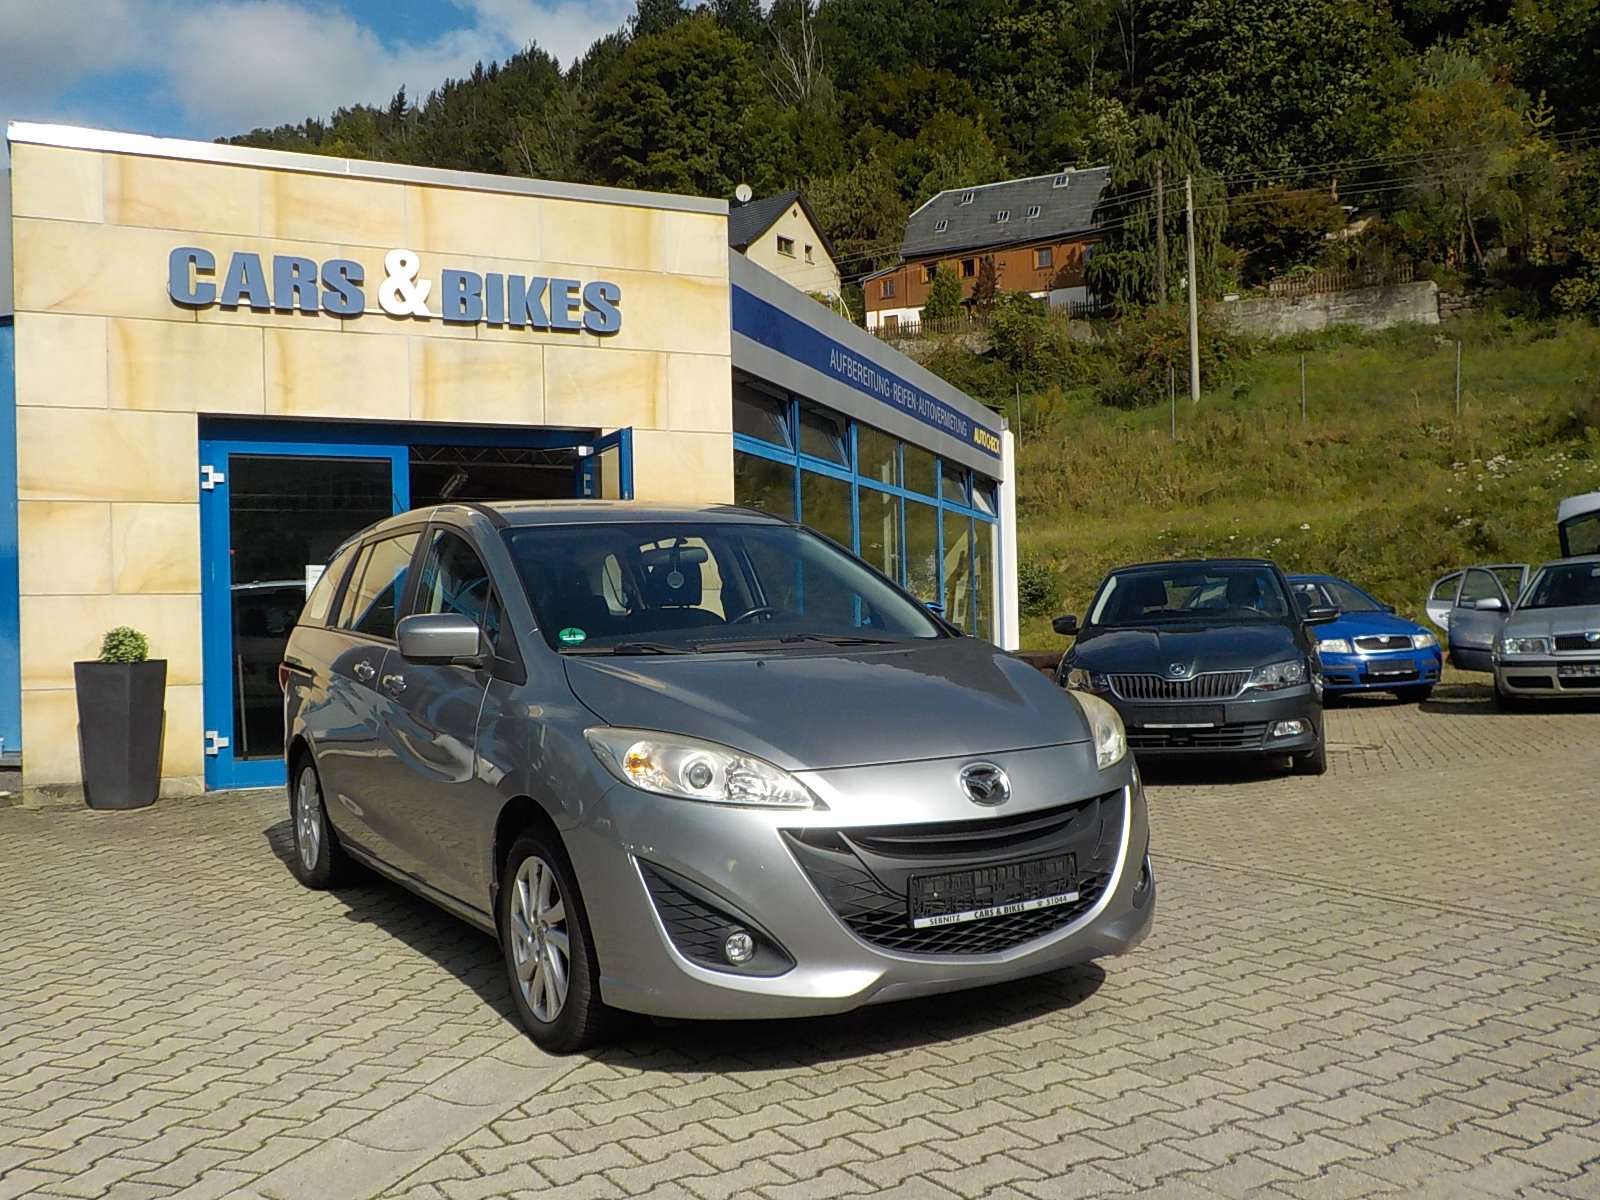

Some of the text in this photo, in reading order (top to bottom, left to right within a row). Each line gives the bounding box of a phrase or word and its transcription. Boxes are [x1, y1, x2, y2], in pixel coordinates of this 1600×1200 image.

[168, 247, 622, 334] CARS & BIKES
[929, 914, 961, 927] SEBNITZ
[974, 909, 994, 920] CARS
[1003, 903, 1025, 915] BIKES
